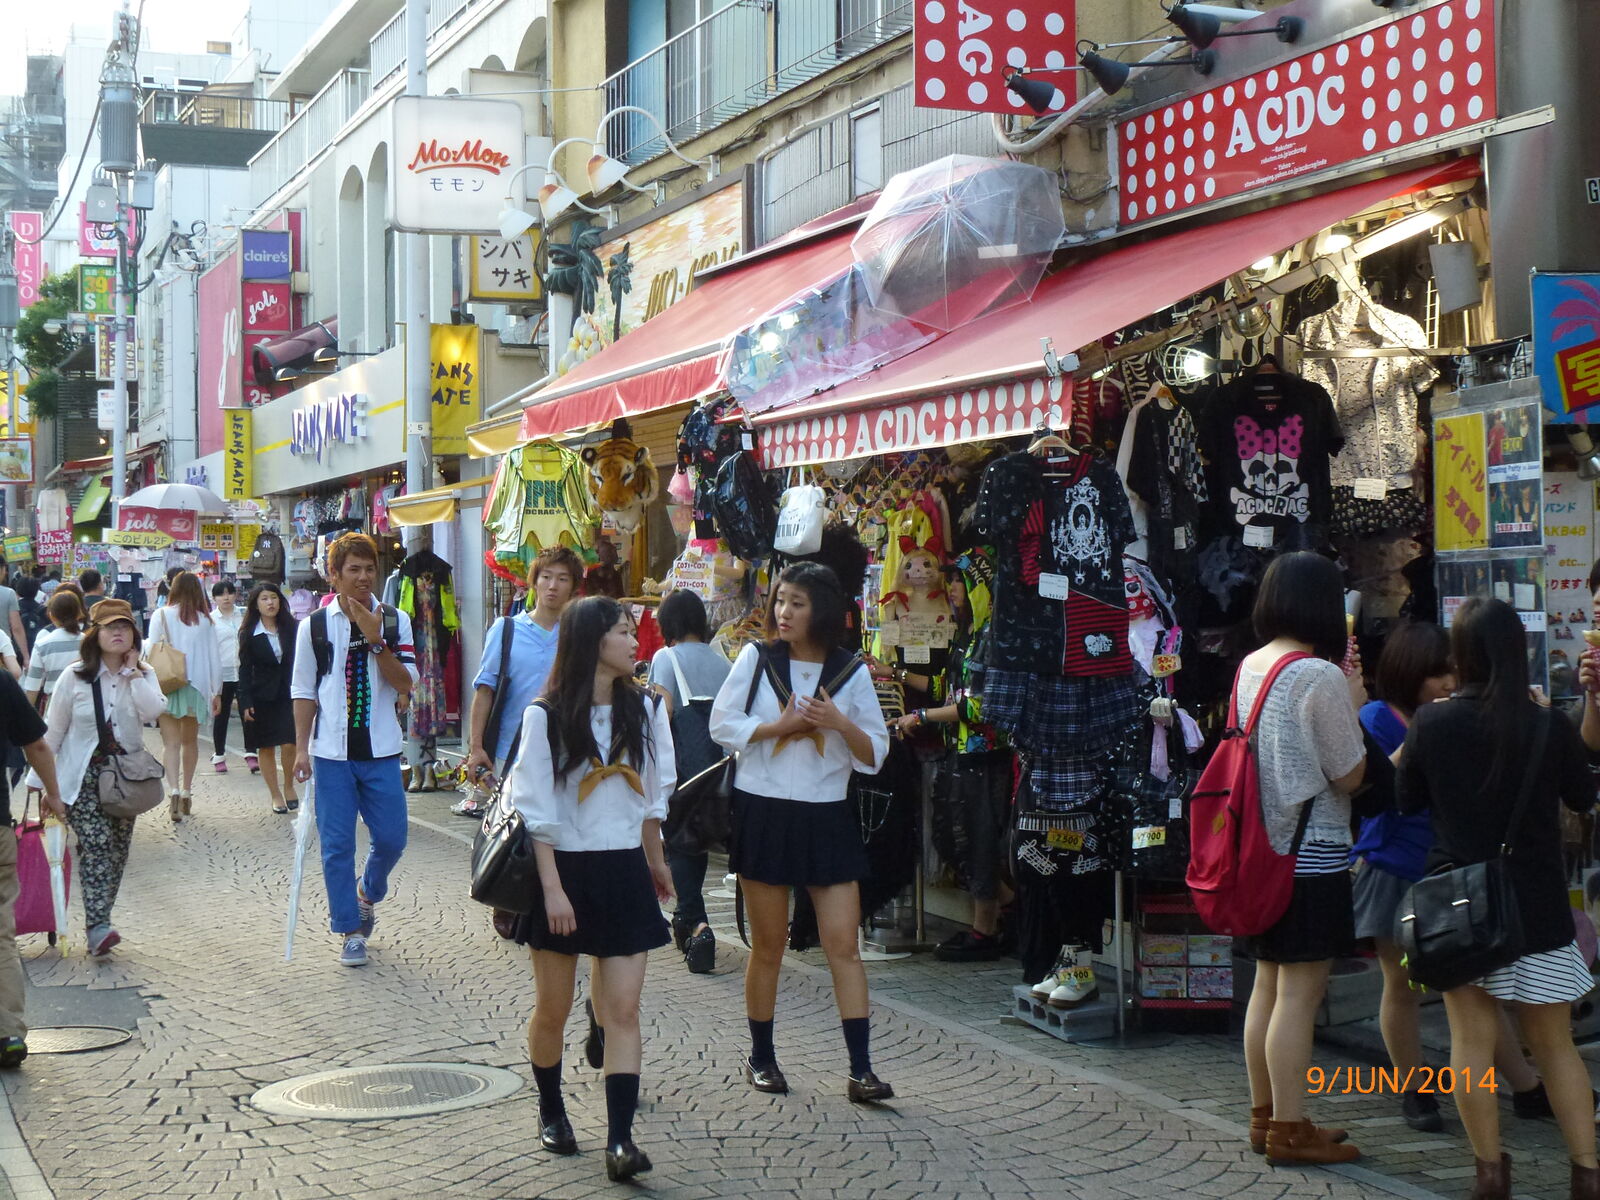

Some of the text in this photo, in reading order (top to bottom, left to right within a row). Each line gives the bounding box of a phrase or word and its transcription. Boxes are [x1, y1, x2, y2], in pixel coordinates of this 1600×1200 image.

[1225, 75, 1345, 158] ACDC
[430, 178, 484, 192] モモン
[20, 222, 34, 299] DAISO
[244, 250, 288, 262] claire's
[481, 239, 522, 259] シバ
[492, 268, 530, 288] サキ
[290, 393, 365, 465] JEANS MATE
[852, 401, 938, 455] ACDC
[229, 414, 245, 495] JEANS MATE
[1237, 496, 1308, 516] ACDCRAG
